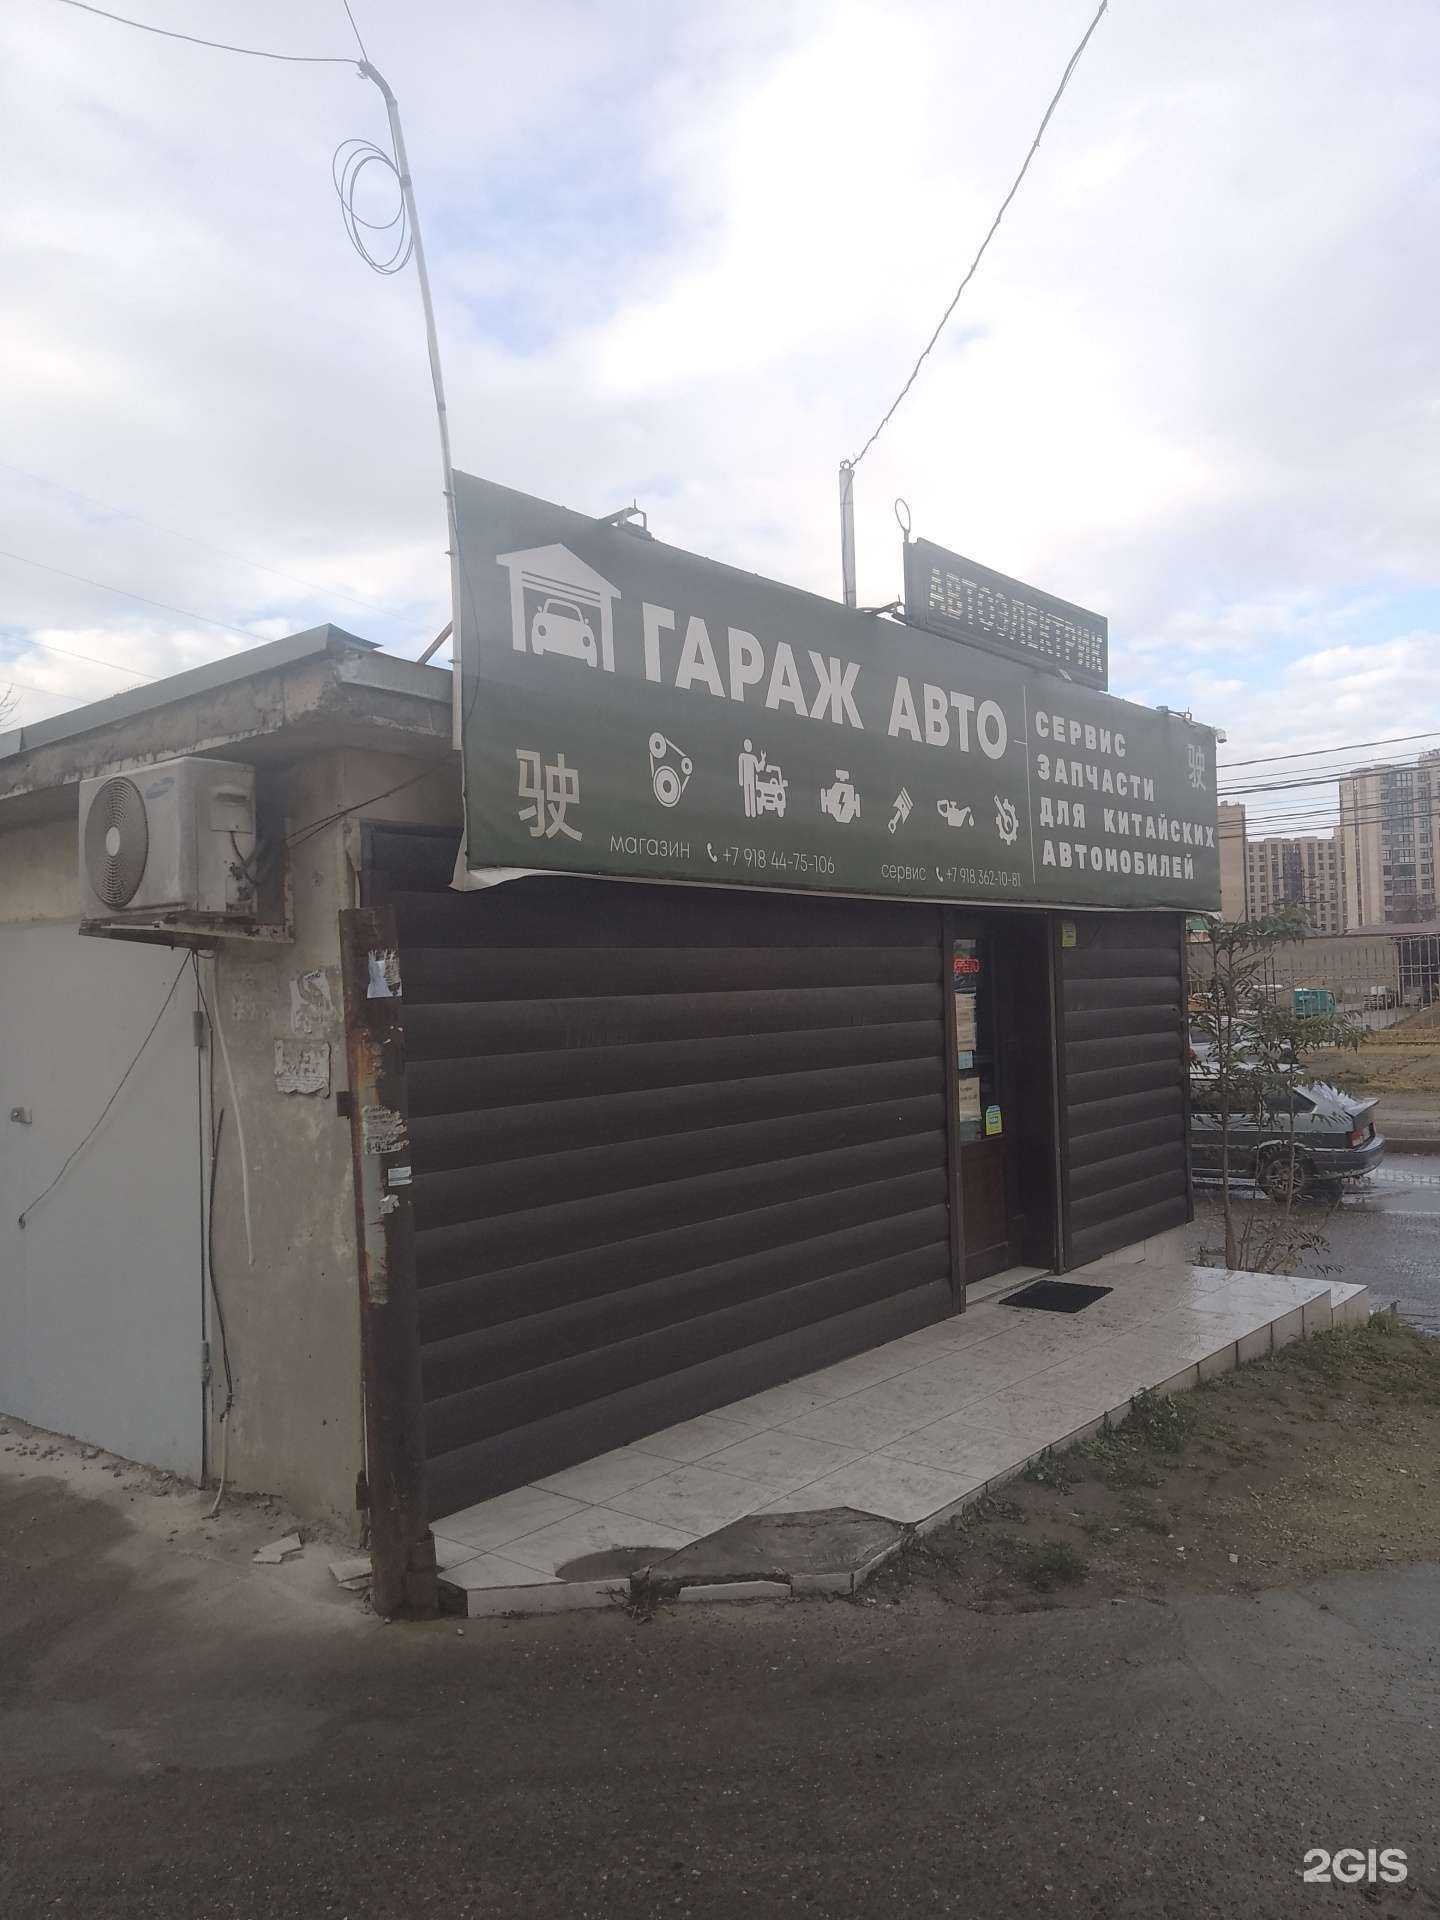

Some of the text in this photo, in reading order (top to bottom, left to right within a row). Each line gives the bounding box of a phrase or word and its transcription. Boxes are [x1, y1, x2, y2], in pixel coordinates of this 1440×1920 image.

[928, 567, 1104, 673] АВТОЭЛЕКТРИК
[642, 601, 1008, 760] ГАРАЖ АВТО
[1035, 711, 1126, 758] СЕРВИС
[516, 748, 583, 841] 驶
[1037, 753, 1155, 802] ЗАПЧАСТИ
[1039, 796, 1215, 848] ДЛЯ КИТАЙСКИХ
[610, 834, 690, 859] магазин
[723, 846, 836, 874] +7 918 44-75-106
[1042, 839, 1194, 880] АВТОМОБИЛЕЙ
[881, 864, 927, 884] сервис
[959, 868, 976, 885] 918
[978, 869, 1022, 888] 362-10-81
